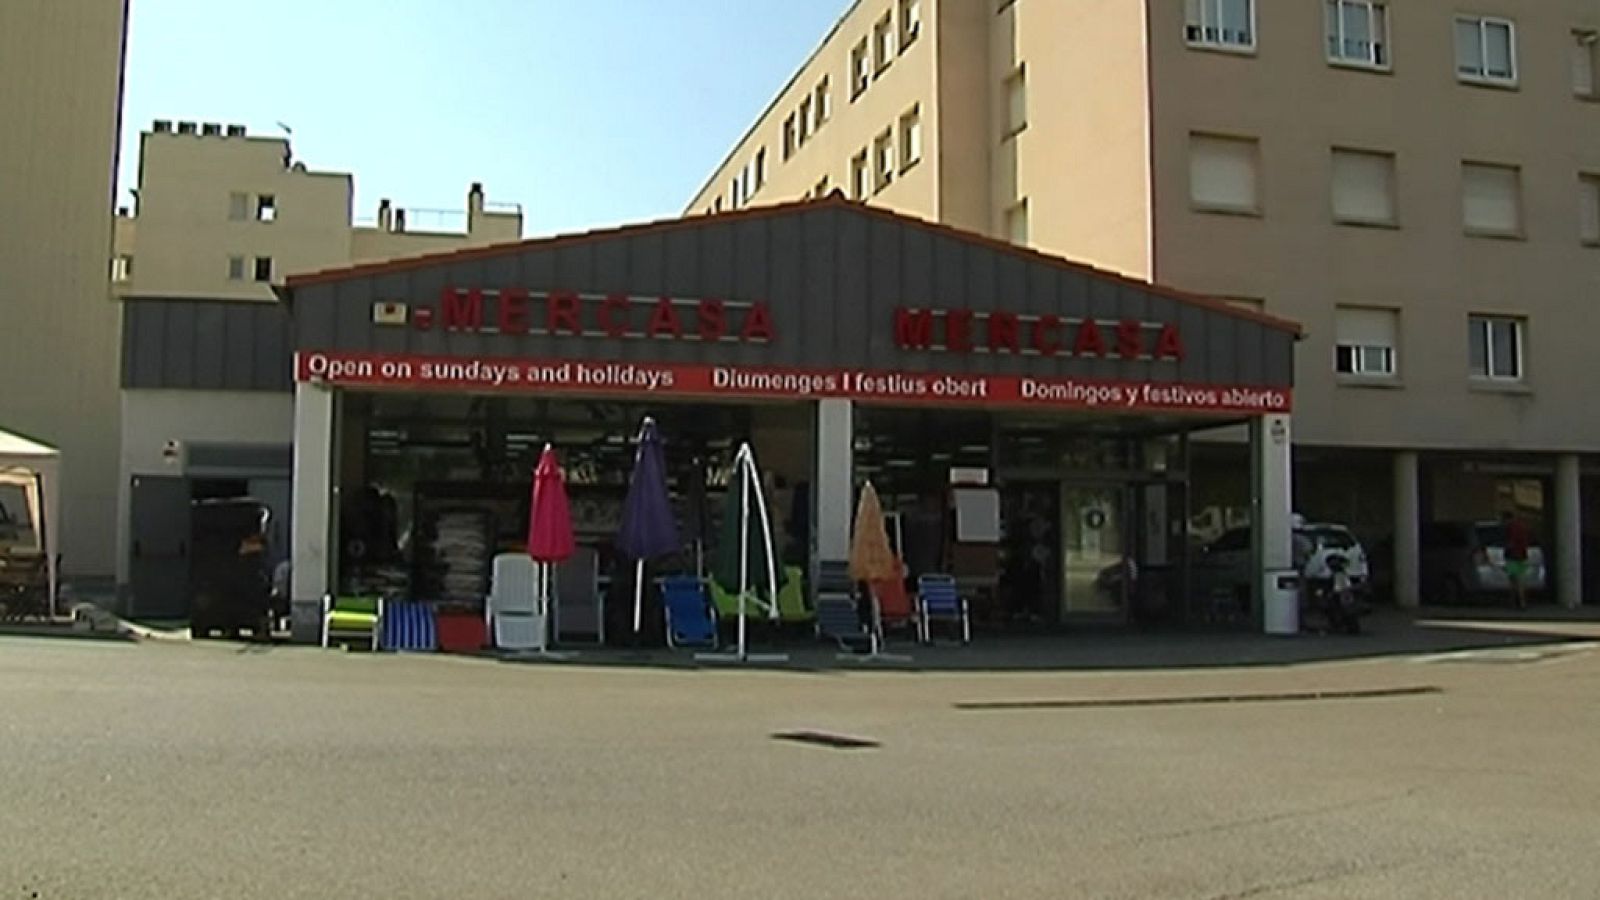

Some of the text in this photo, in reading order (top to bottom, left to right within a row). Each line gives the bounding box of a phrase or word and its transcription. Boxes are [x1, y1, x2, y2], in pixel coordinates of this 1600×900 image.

[443, 287, 775, 341] MERCASA
[894, 308, 1183, 360] MERCASA
[308, 354, 675, 391] Open on sundays and holidays
[713, 368, 837, 394] Diumenges
[854, 374, 926, 395] festius
[932, 376, 988, 398] obert
[1021, 380, 1286, 410] Domingos y festivos abierto
